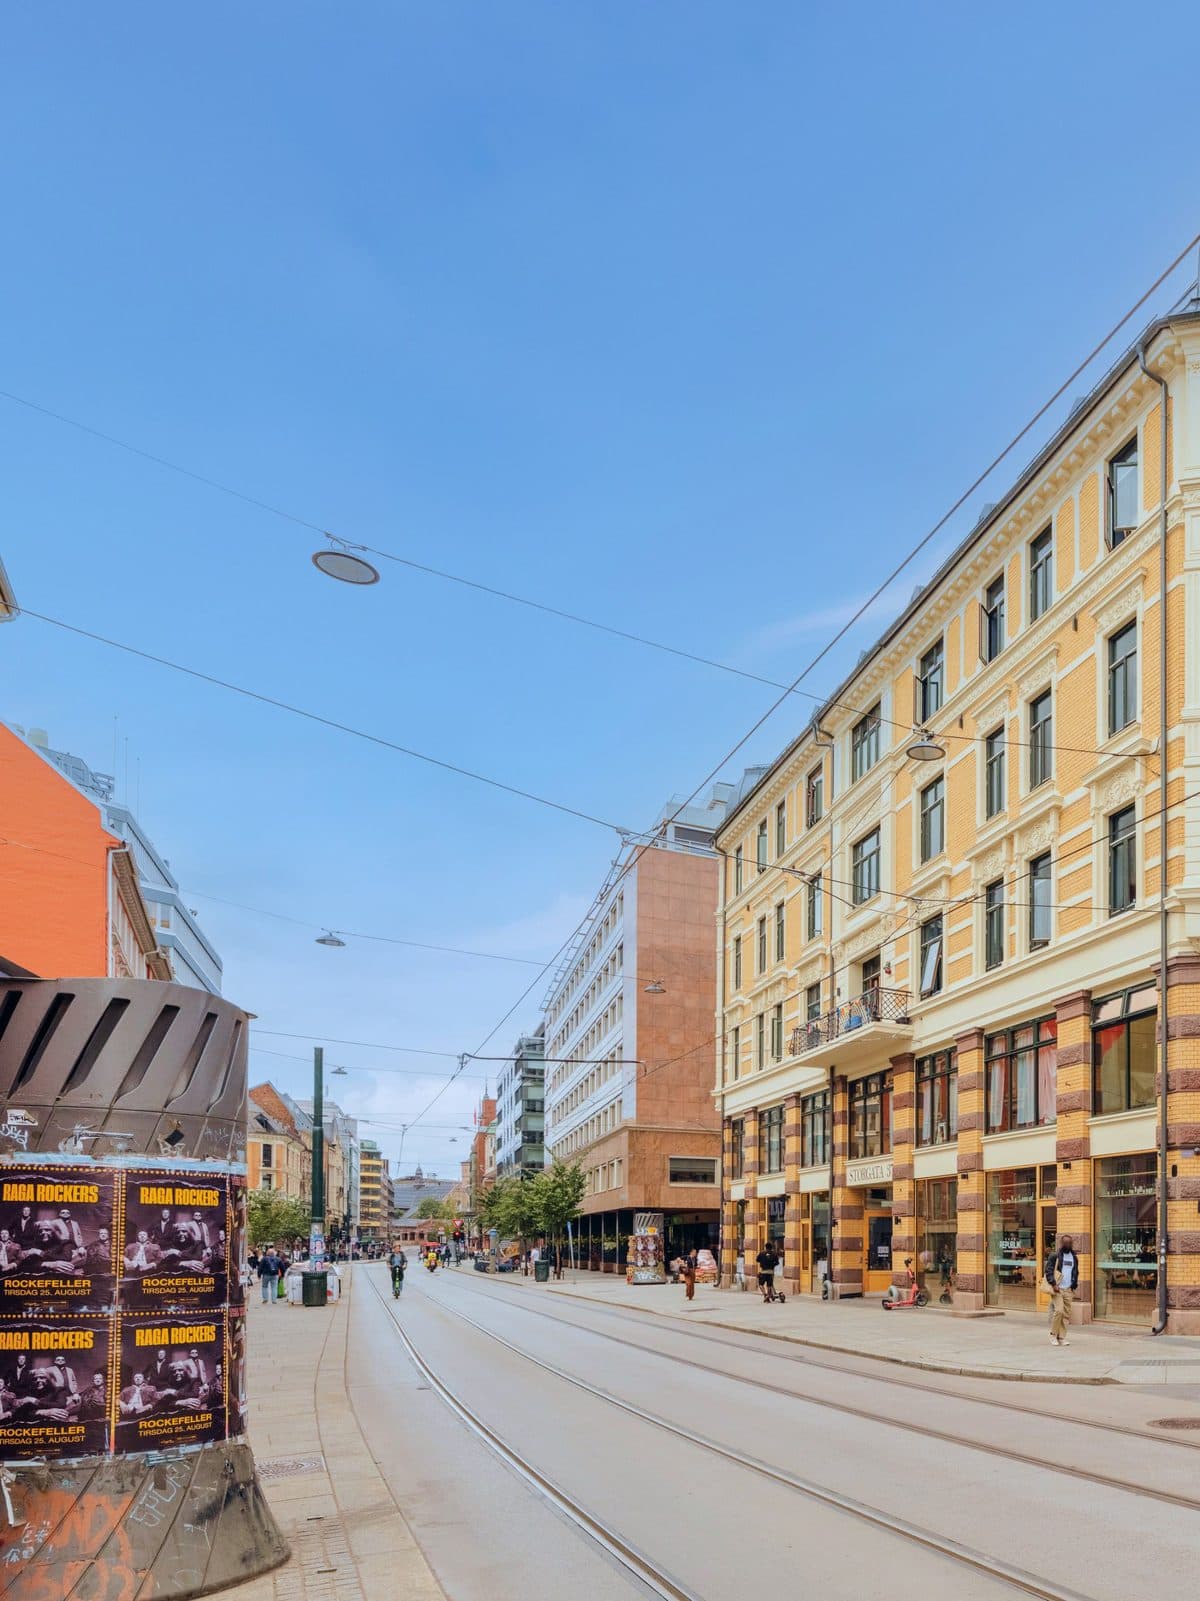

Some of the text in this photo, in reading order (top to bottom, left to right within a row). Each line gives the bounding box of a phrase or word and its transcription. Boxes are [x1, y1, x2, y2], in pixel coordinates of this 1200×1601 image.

[3, 1184, 99, 1203] RAGA ROCKERS
[140, 1187, 219, 1207] RAGA ROCKERS
[4, 1279, 92, 1288] ROCKEFELLER
[142, 1277, 215, 1287] ROCKEFELLER
[142, 1287, 176, 1295] TIRSDAG
[0, 1330, 94, 1350] RAGA ROCKERS
[135, 1325, 216, 1347] RAGA ROCKERS
[138, 1413, 213, 1429] ROCKEFELLER
[0, 1425, 86, 1437] ROCKEFELLER
[138, 1422, 213, 1437] TIRSDAG 25. AUGUST
[48, 1434, 86, 1443] AUGUST
